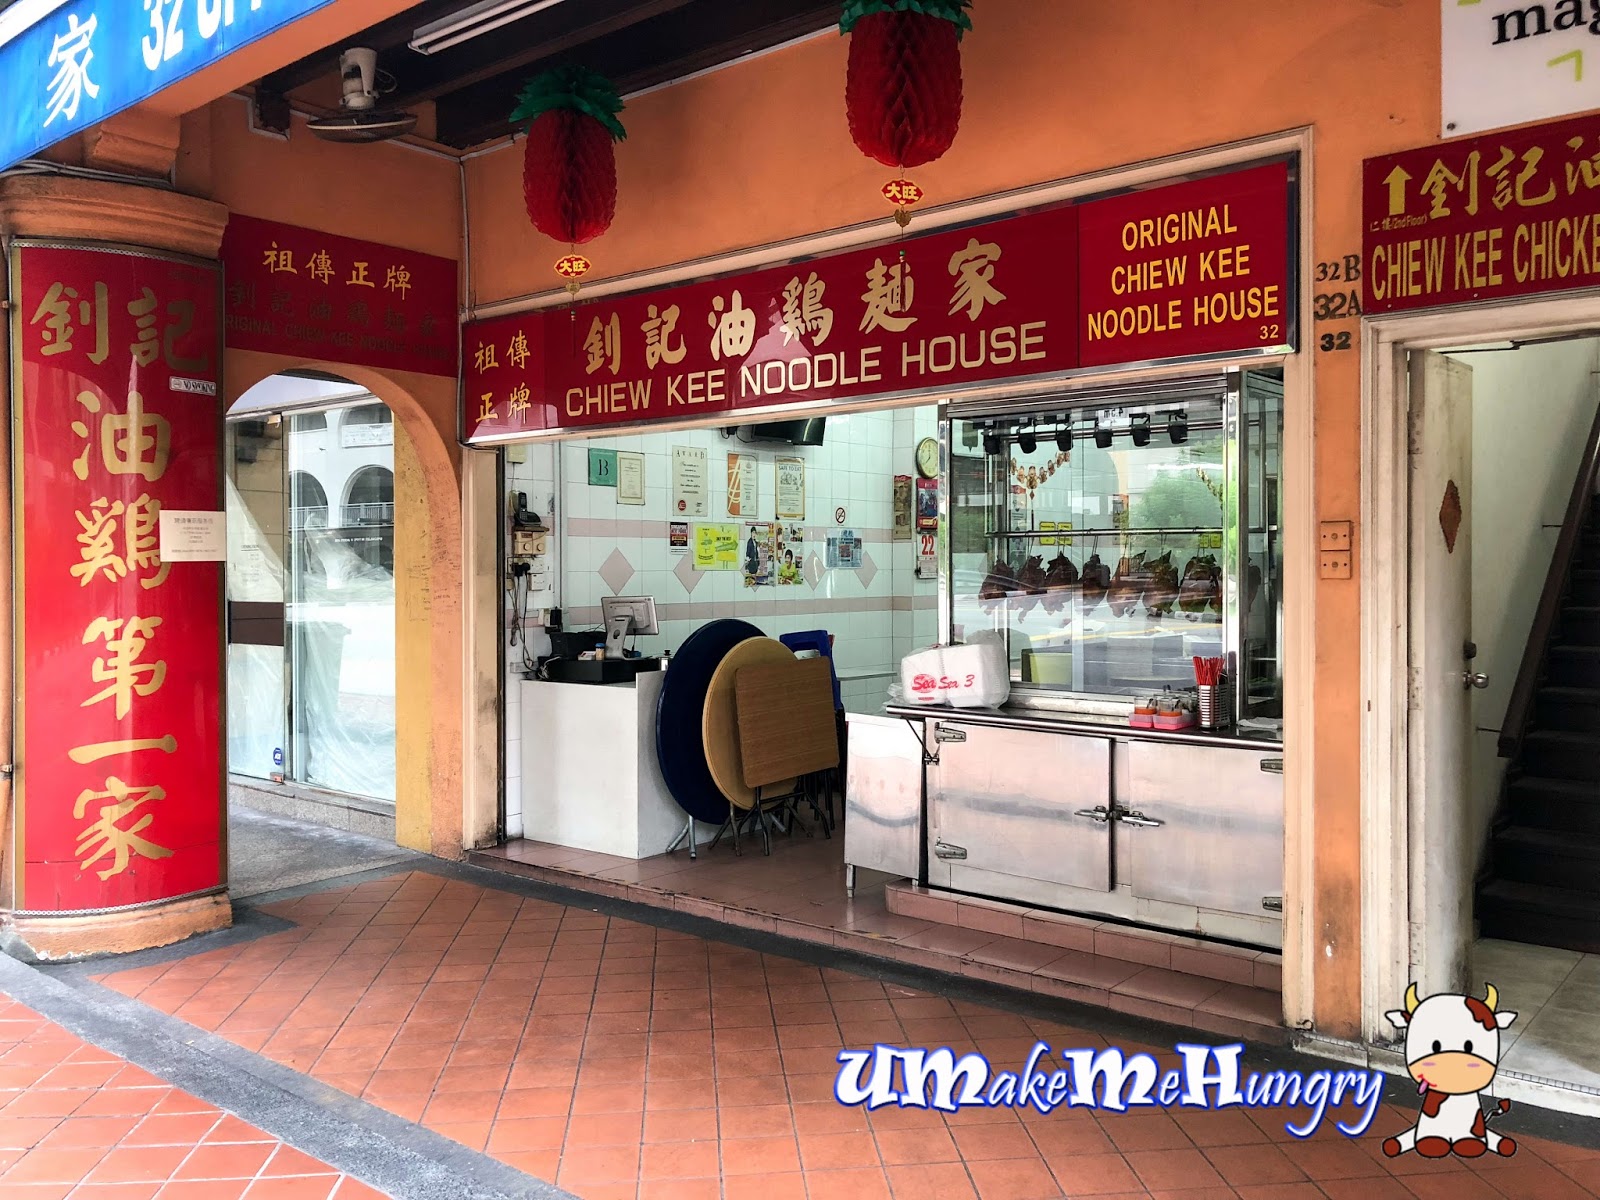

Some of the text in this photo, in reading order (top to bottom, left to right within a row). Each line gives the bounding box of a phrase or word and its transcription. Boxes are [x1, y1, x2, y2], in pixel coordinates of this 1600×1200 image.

[142, 0, 184, 71] 32
[43, 13, 100, 128] 家
[886, 183, 919, 201] 大旺
[1122, 204, 1238, 251] ORIGINAL
[262, 240, 412, 301] 祖傳正牌
[558, 260, 587, 273] 大旺
[1111, 244, 1250, 295] CHIEW KEE
[1315, 254, 1361, 282] 32B
[1371, 236, 1446, 301] CHIEW
[1454, 228, 1503, 290] KEE
[225, 313, 278, 336] RIGINAL
[1088, 285, 1279, 341] NOODLE HOUSE
[1313, 289, 1362, 321] 32A
[474, 330, 531, 376] 祖傳
[1259, 324, 1279, 340] 32
[1320, 331, 1352, 352] 32
[565, 320, 1047, 418] CHIEW KEE NOODLE HOUSE
[475, 381, 532, 425] 正牌
[598, 458, 609, 476] B
[921, 534, 935, 556] 22
